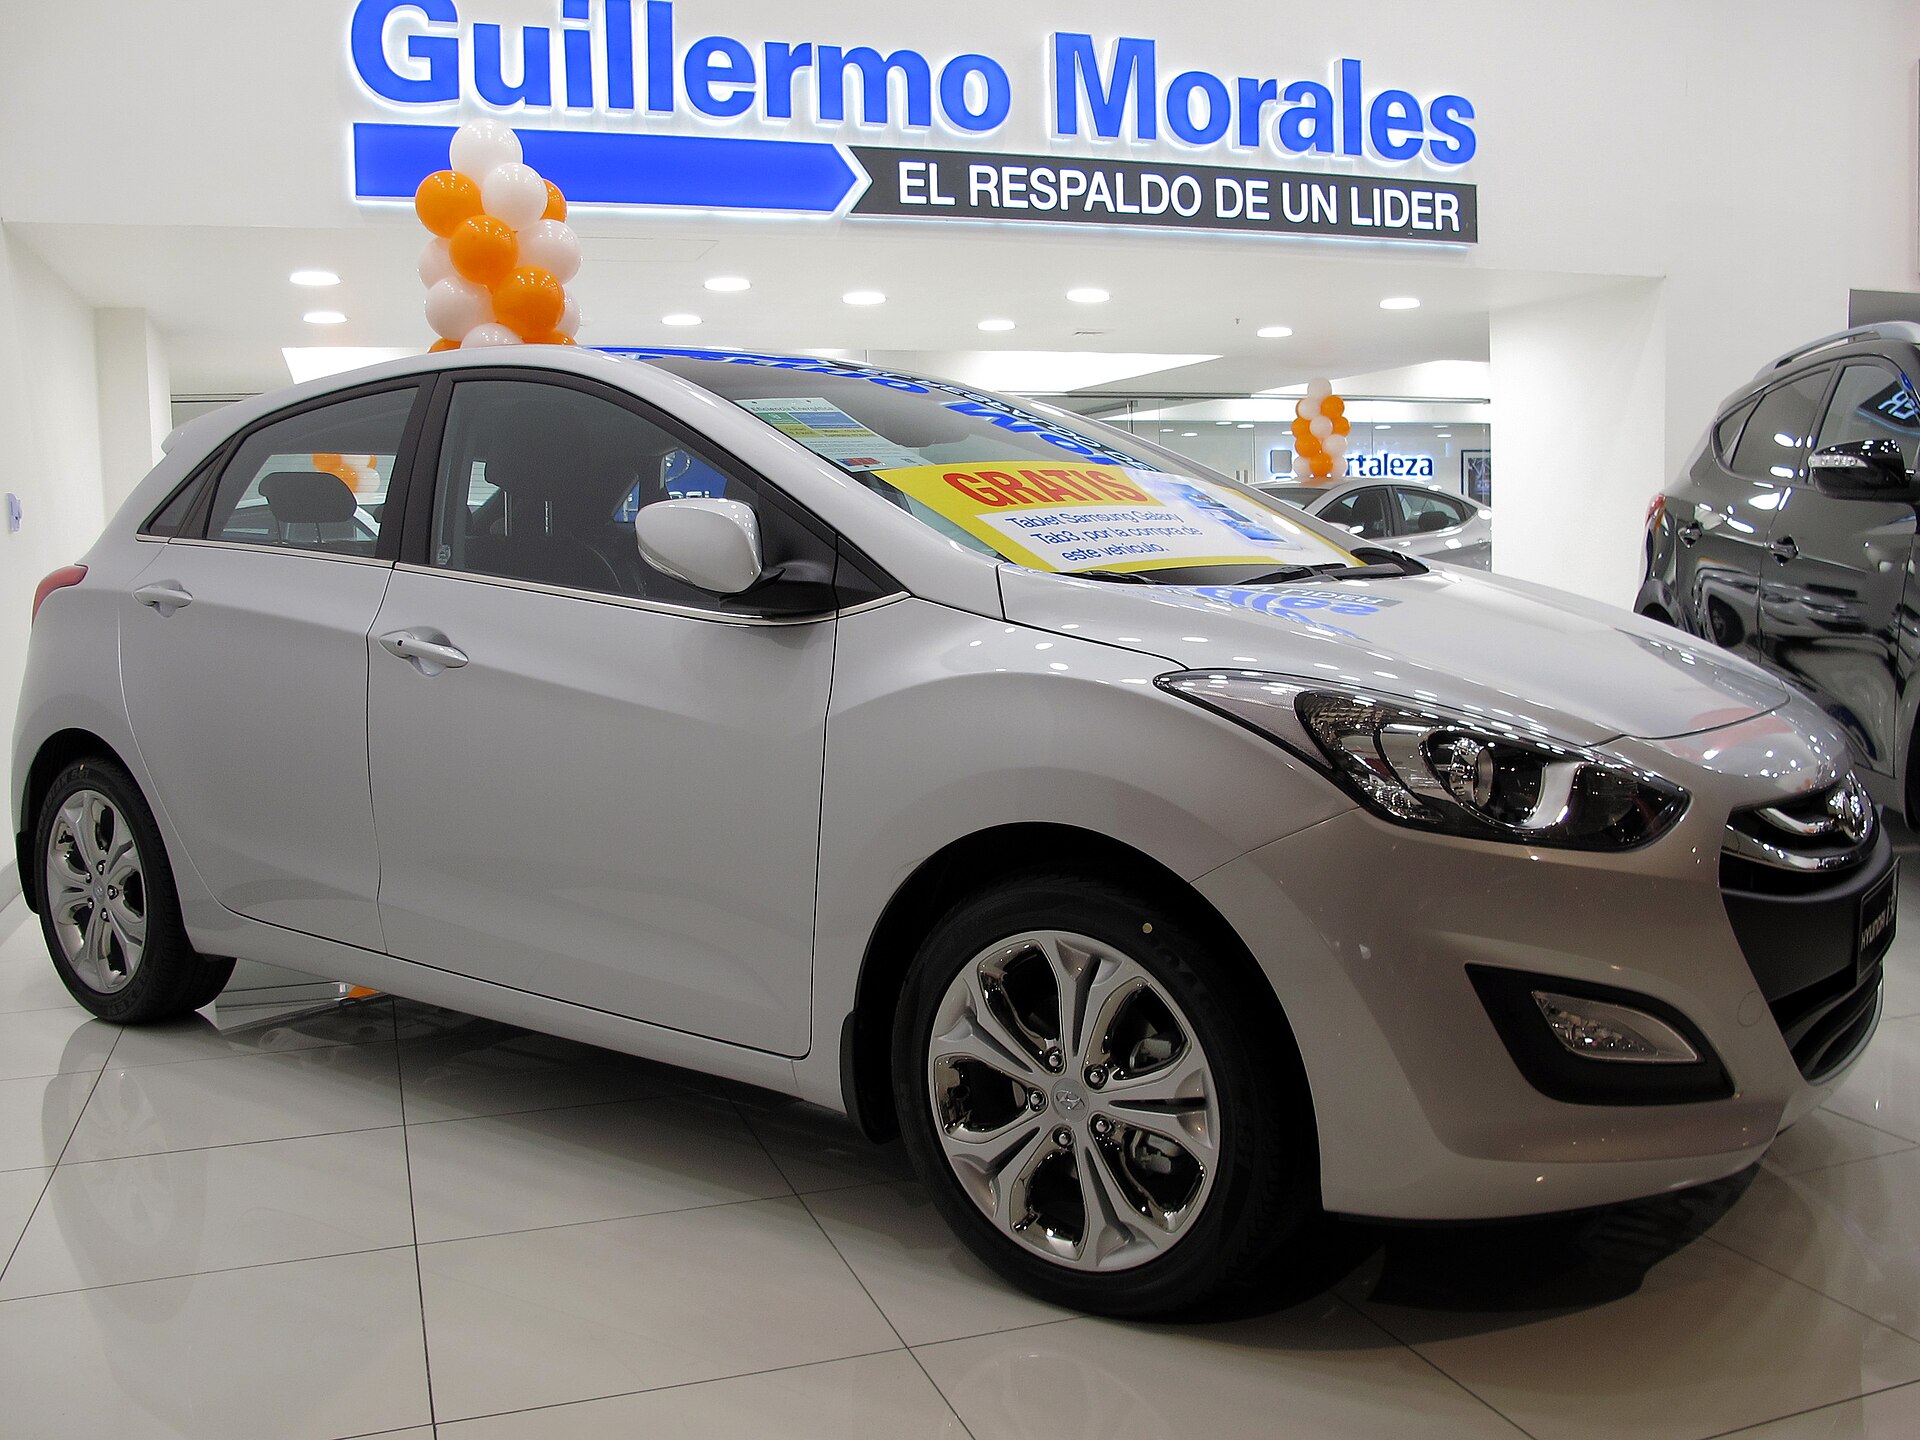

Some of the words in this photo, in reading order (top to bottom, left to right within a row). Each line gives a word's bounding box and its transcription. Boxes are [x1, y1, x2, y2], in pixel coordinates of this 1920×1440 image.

[350, 0, 1011, 133] Guillermo
[1051, 31, 1477, 164] Morales
[899, 161, 956, 206] EL
[968, 163, 1202, 218] RESPALDO
[1214, 177, 1271, 221] DE
[1281, 183, 1339, 226] UN
[1350, 187, 1461, 233] LIDER
[1345, 453, 1434, 477] rtaleza
[942, 469, 1149, 507] GRATIS
[1005, 514, 1066, 529] Tablet
[1059, 513, 1140, 524] Samsung
[1131, 510, 1185, 523] Galaxy
[1030, 530, 1089, 545] Tab3,
[1082, 529, 1113, 543] por
[1106, 526, 1131, 538] la
[1127, 527, 1184, 538] compra
[1181, 525, 1203, 536] de
[1061, 547, 1102, 562] este
